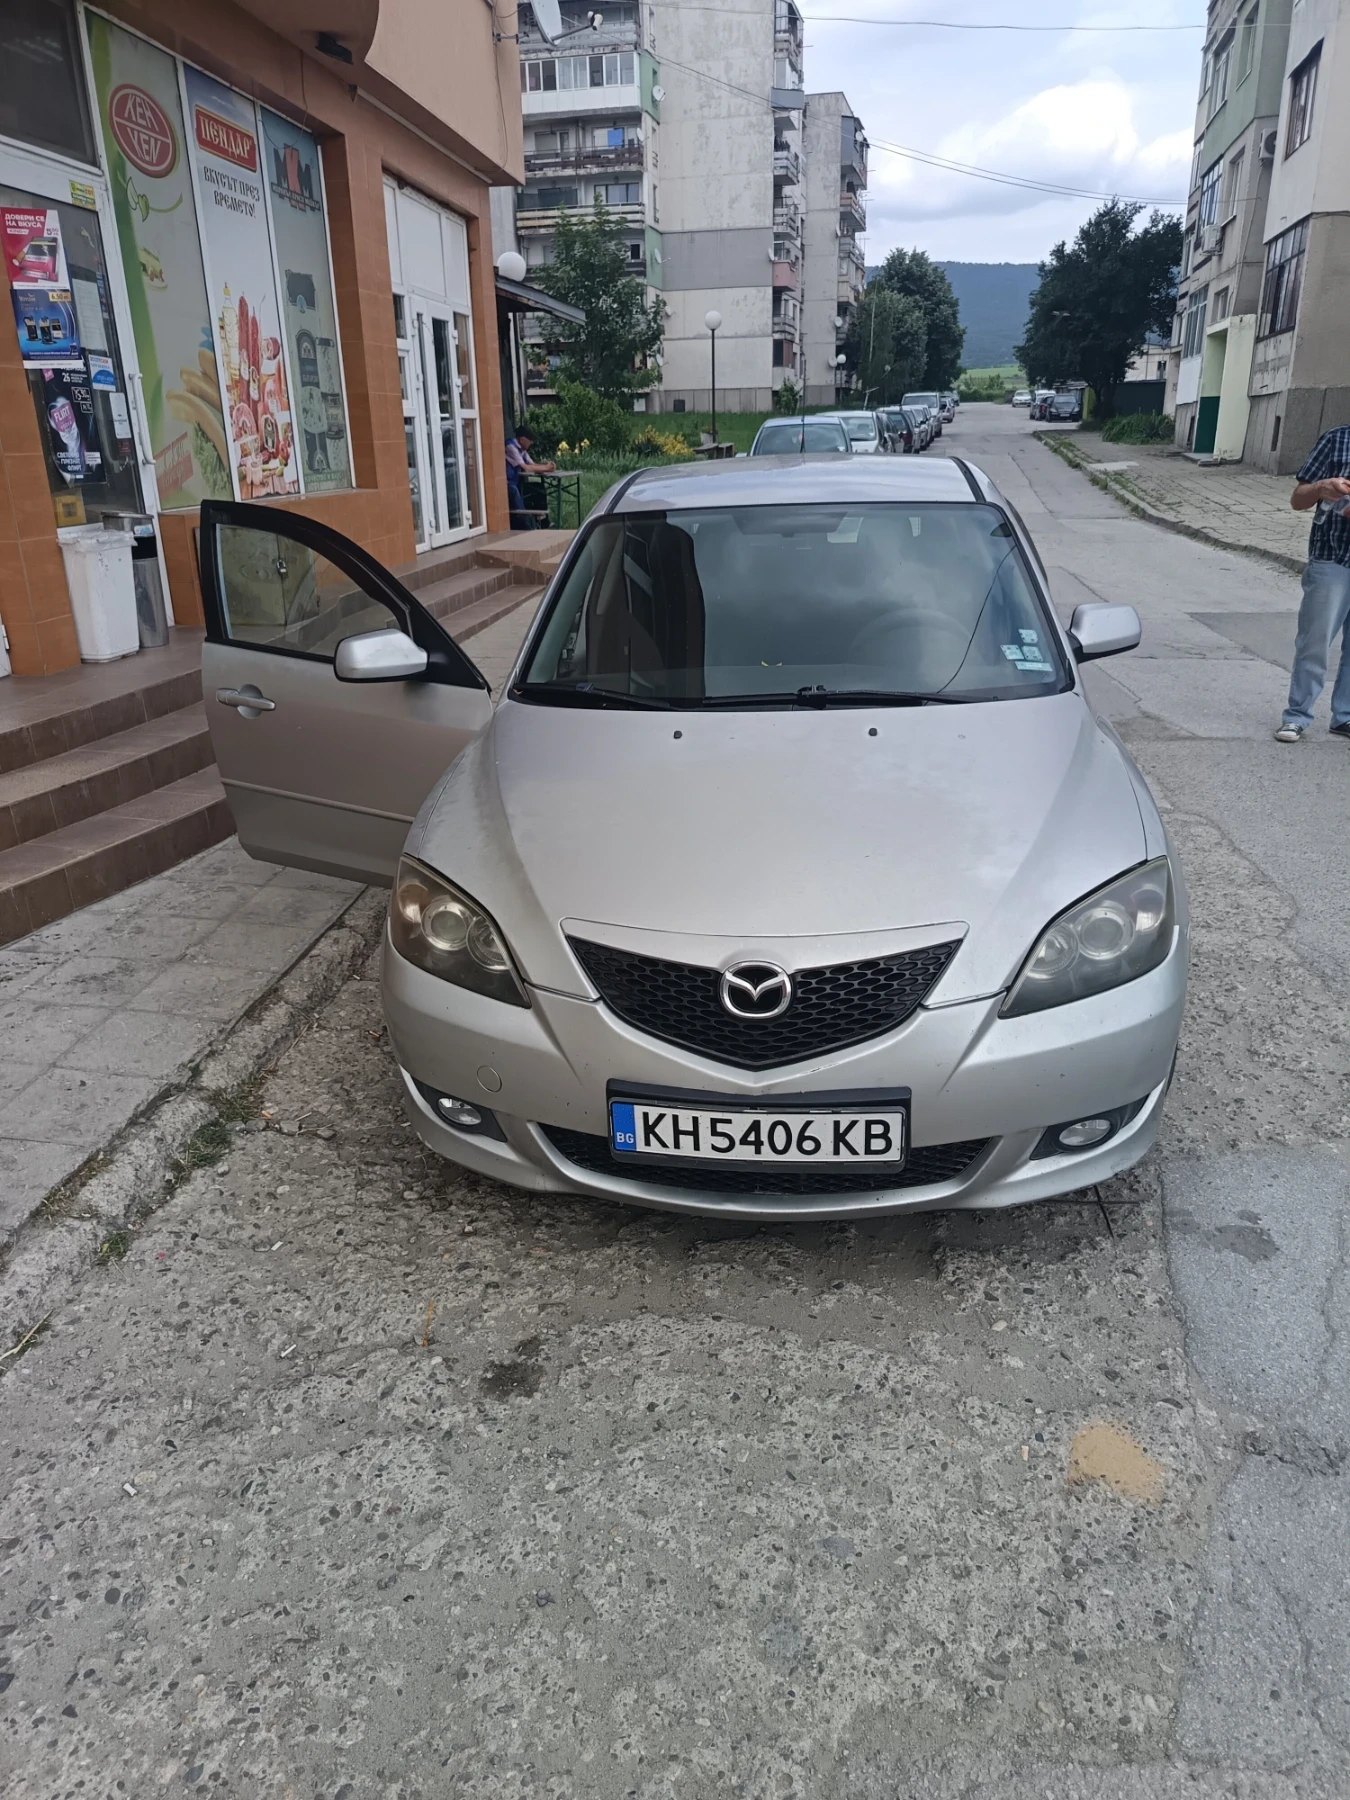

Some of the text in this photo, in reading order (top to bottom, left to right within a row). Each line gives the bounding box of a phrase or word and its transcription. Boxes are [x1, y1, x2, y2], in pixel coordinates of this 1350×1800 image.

[124, 93, 159, 132] КЕН
[126, 127, 161, 164] KEN
[203, 166, 238, 193] ВКУСЪТ
[239, 180, 260, 202] ПРЕЗ
[5, 213, 35, 222] ДОВЕРИ
[54, 405, 70, 423] FLIRT
[616, 1132, 634, 1144] BG
